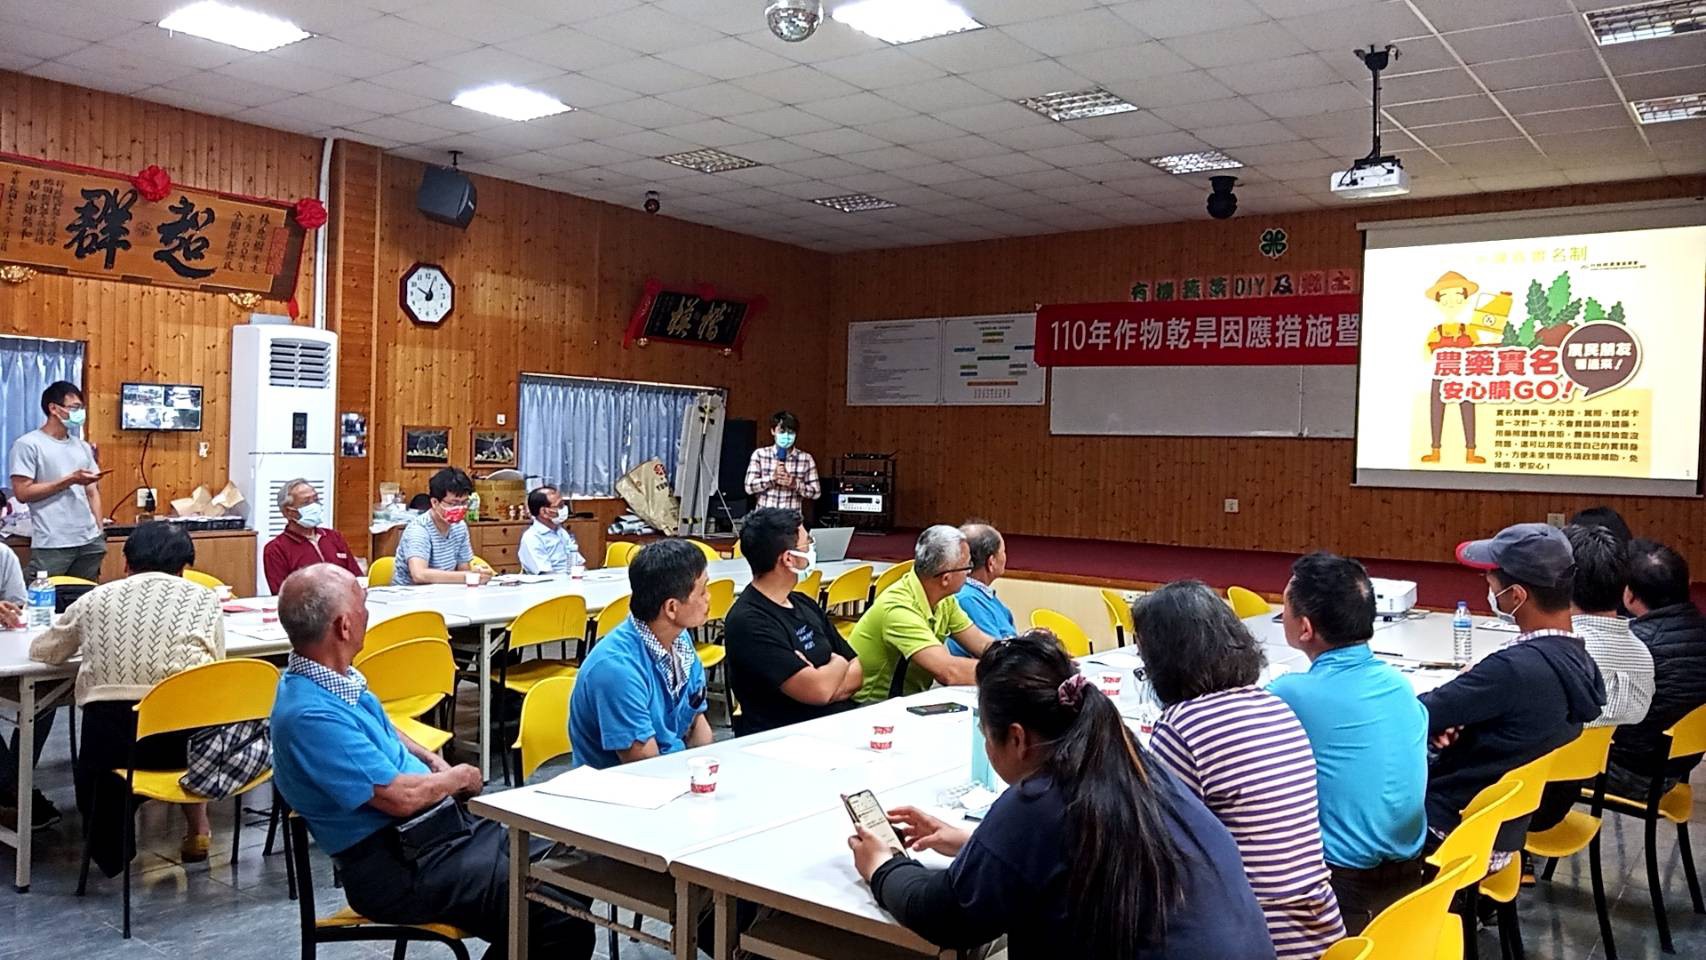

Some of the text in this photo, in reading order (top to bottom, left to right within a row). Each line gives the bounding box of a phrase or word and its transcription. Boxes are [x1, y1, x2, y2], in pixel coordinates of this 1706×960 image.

[1050, 313, 1360, 351] 110年作物乾旱因應措施暨
[1434, 349, 1559, 376] 農藥實名
